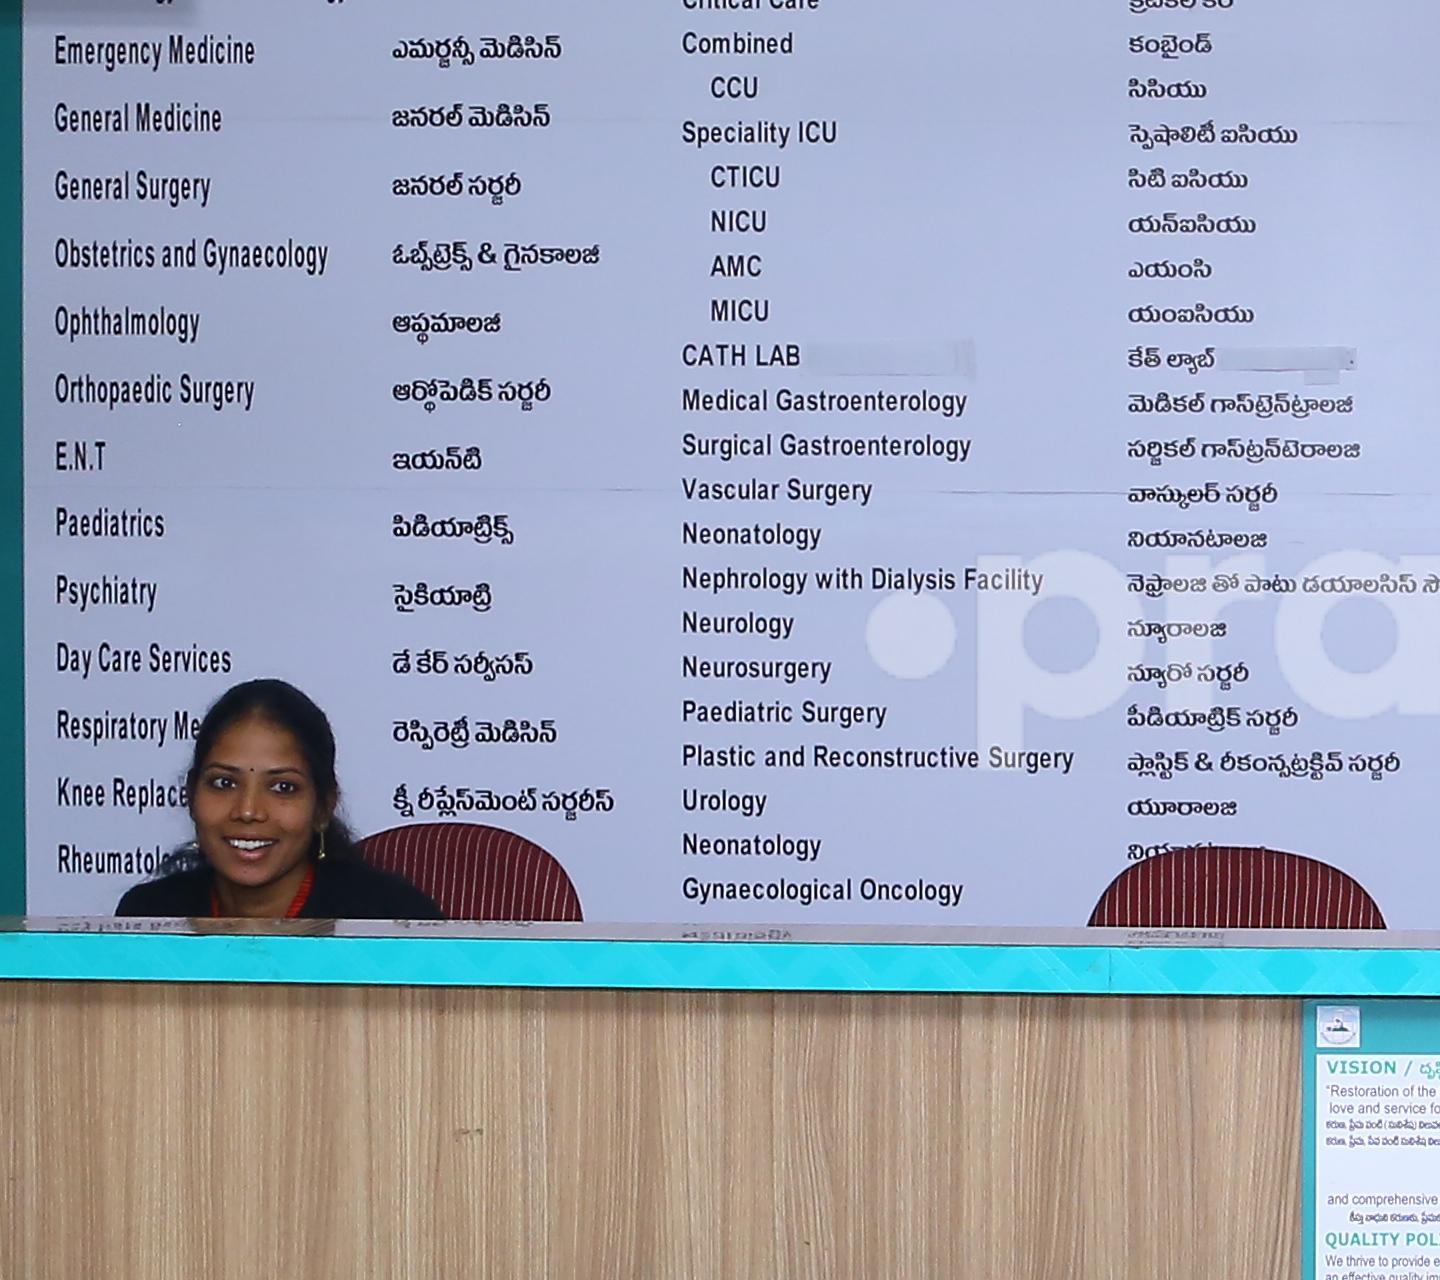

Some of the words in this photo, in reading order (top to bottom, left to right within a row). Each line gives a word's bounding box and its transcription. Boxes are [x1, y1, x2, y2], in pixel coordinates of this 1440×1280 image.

[55, 35, 162, 72] Emergency
[169, 35, 254, 64] Medicine
[711, 76, 757, 98] CCU
[55, 170, 129, 200] General
[136, 170, 210, 208] Surgery
[712, 210, 766, 232] NICU
[55, 306, 199, 343] Ophthalmology
[56, 441, 106, 470] E.N.T
[683, 522, 821, 550] Neonatology
[57, 575, 157, 612] Psychiatry
[57, 642, 92, 679] Day
[99, 642, 141, 672] Care
[149, 643, 231, 673] Services
[683, 789, 767, 817] Urology
[683, 877, 851, 906] Gynaecological
[860, 878, 963, 906] Oncology
[1327, 1061, 1396, 1074] VISION
[1403, 1085, 1414, 1097] of
[1418, 1085, 1436, 1097] the
[1330, 1102, 1354, 1114] love
[1358, 1102, 1380, 1114] and
[1384, 1105, 1426, 1114] service
[1325, 1232, 1400, 1249] QUALITY
